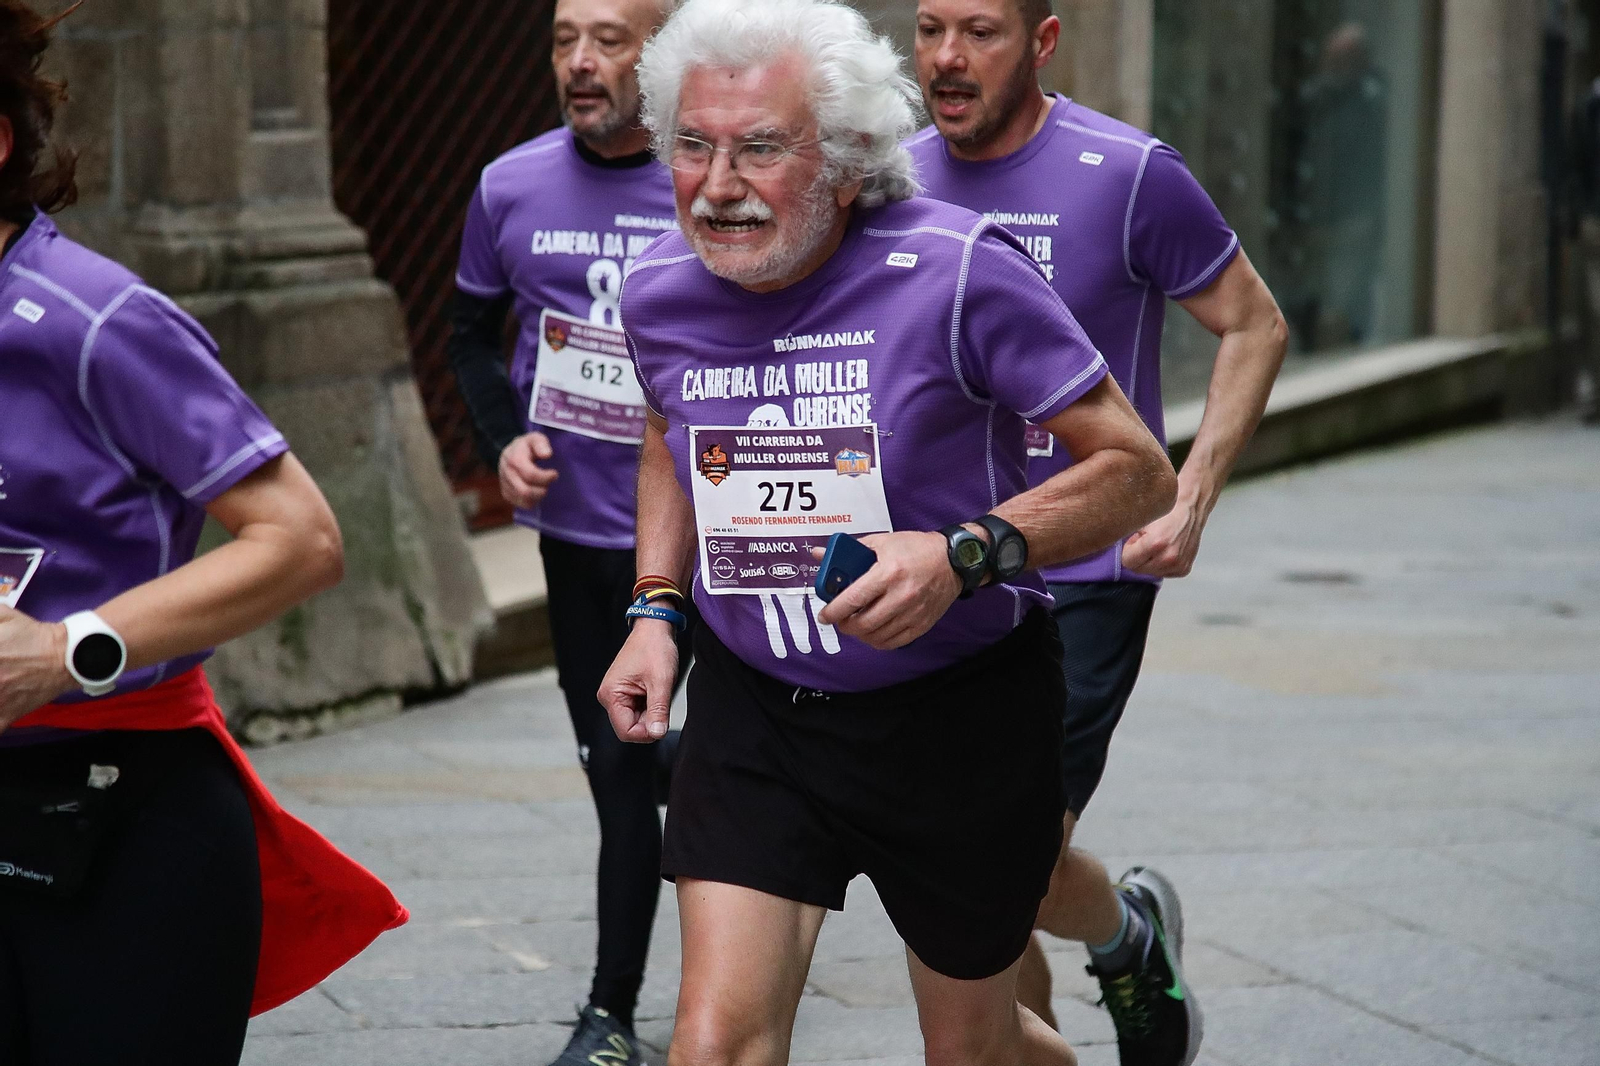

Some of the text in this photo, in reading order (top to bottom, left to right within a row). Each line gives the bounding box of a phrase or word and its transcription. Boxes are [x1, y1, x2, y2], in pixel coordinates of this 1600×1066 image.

[531, 229, 600, 257] CARREIRA
[602, 231, 625, 258] DA
[773, 330, 876, 352] RUNMANIAK
[581, 360, 622, 386] 612
[682, 359, 869, 401] CARREIRA DA MULLER
[793, 393, 872, 427] OURENSE
[735, 435, 823, 447] VII CARREIRA DA
[733, 452, 829, 464] MULLER OURENSE
[757, 481, 818, 512] 275
[731, 514, 852, 525] ROSENDO FERNANDEZ FERNANDEZ
[772, 565, 796, 576] ABRIL
